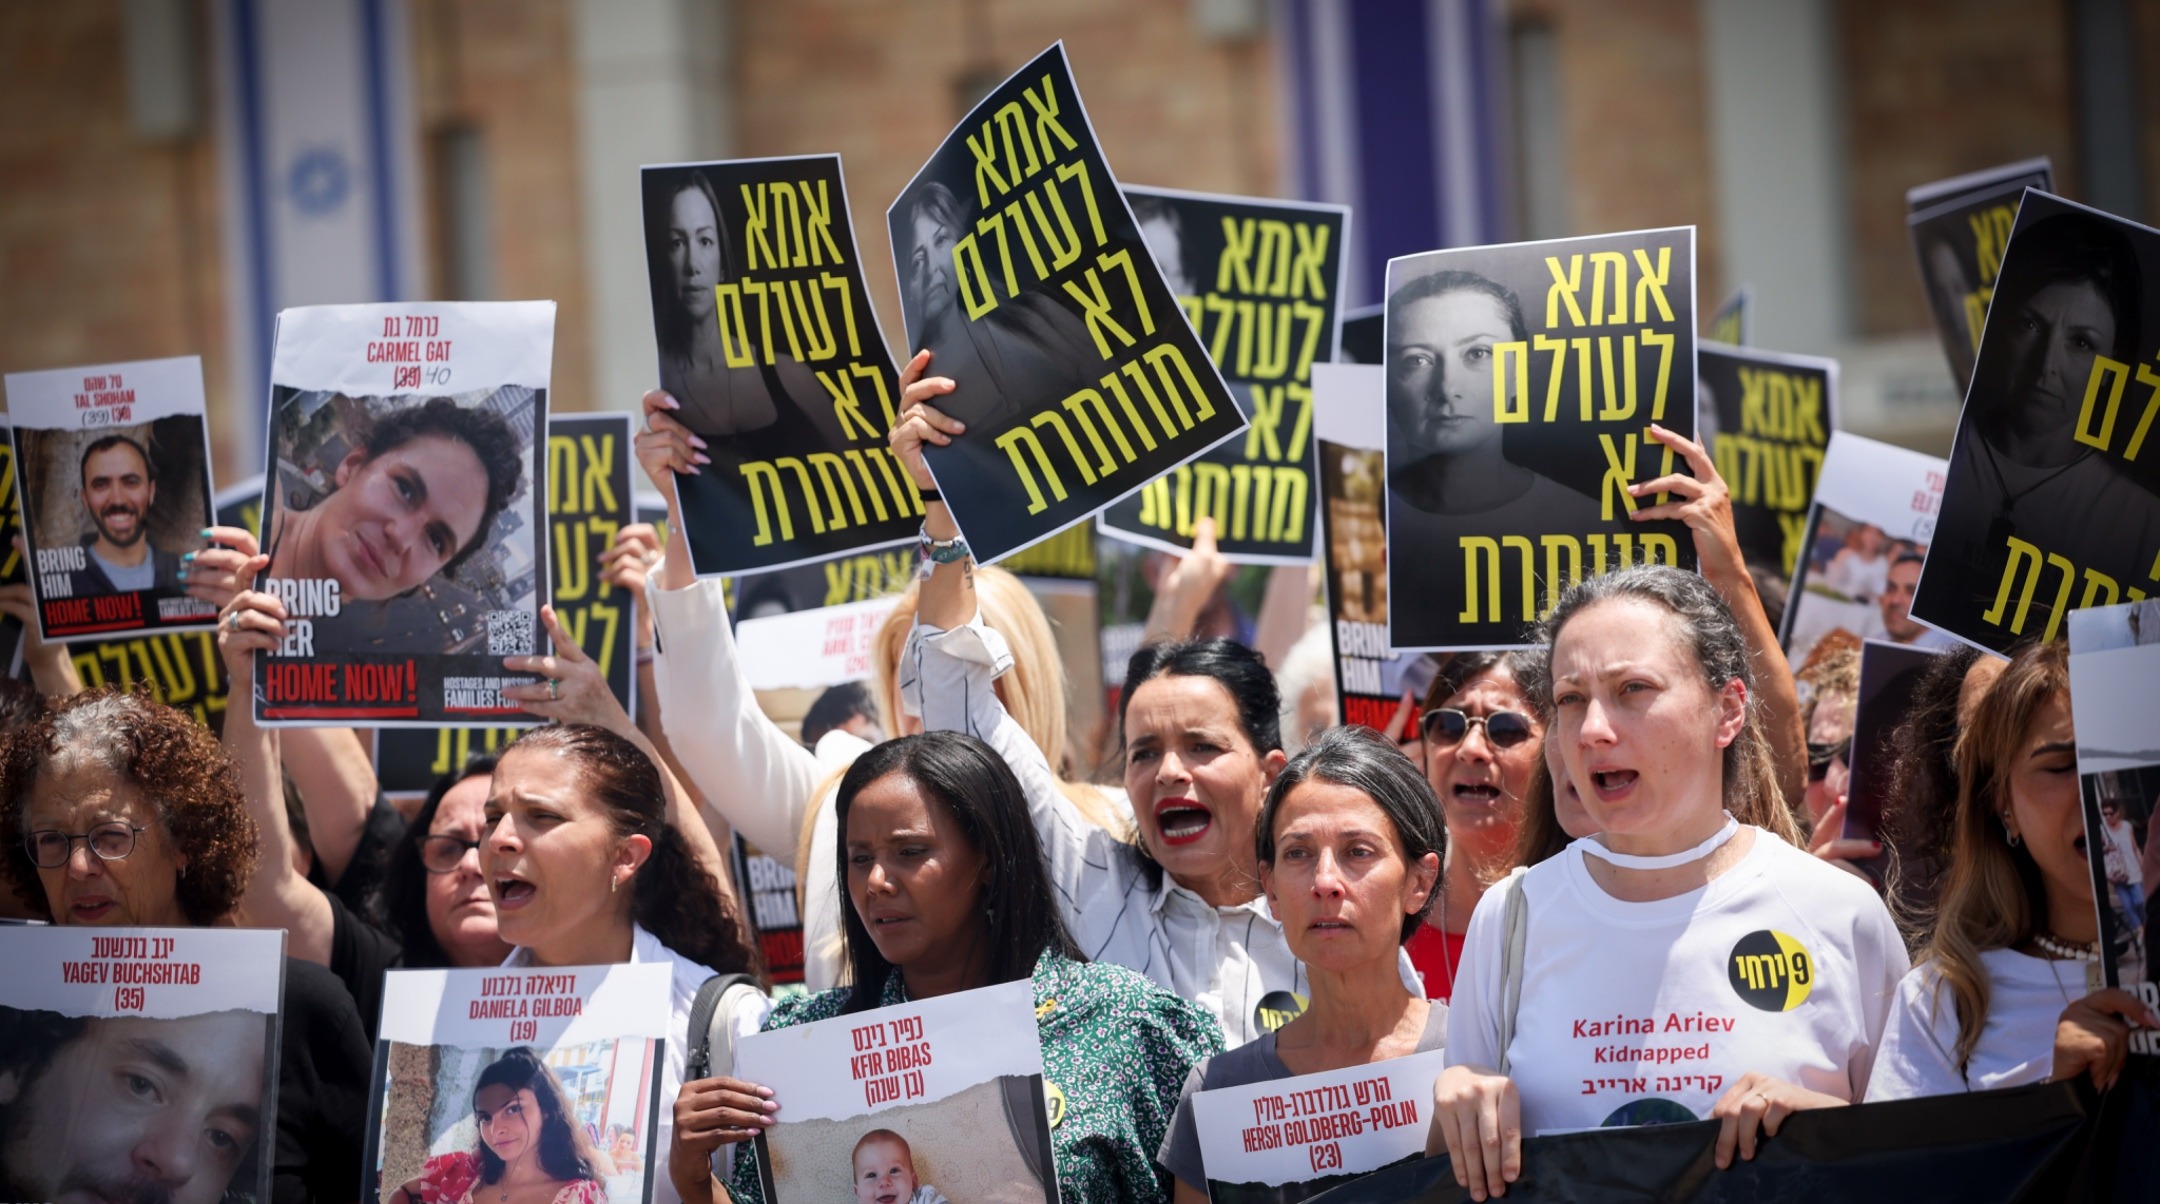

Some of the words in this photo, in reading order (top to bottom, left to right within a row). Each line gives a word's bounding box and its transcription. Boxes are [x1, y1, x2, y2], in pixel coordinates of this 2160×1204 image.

[967, 74, 1078, 210] אמא
[740, 179, 845, 271] אמא
[952, 159, 1109, 322] לעולם
[1217, 215, 1331, 299] אמא
[1545, 247, 1675, 329] אמא
[1062, 249, 1138, 361] לא
[383, 316, 401, 338] גת
[406, 315, 439, 338] כרמל
[715, 275, 862, 369] לעולם
[366, 341, 422, 363] CARMEL
[425, 340, 452, 362] GAT
[425, 365, 452, 386] 40
[1493, 330, 1675, 424] לעולם
[75, 394, 91, 408] TAL
[94, 389, 136, 407] SHOHAM
[815, 361, 898, 441] לא
[1737, 366, 1826, 445] אמא
[81, 408, 110, 427] (39)
[994, 343, 1217, 516] מוותרת
[1244, 383, 1313, 463] לא
[549, 433, 618, 514] אמ
[1599, 427, 1675, 522] לא
[36, 545, 86, 576] BRING
[40, 572, 74, 600] HIM
[45, 600, 91, 626] HOME
[94, 592, 143, 621] NOW!
[1337, 619, 1400, 662] BRIN
[266, 663, 338, 702] HOME
[344, 659, 417, 702] NOW!
[443, 676, 483, 689] HOSTAGES
[484, 677, 501, 689] AND
[1340, 656, 1383, 695] HIM
[444, 689, 495, 708] FAMILIES
[753, 889, 799, 930] HIM
[151, 937, 175, 960] יגב
[62, 962, 109, 984] YAGEV
[112, 963, 201, 985] BUCHSHTAB
[525, 975, 576, 995] דניאלה
[1736, 952, 1786, 991] ירחי
[1792, 951, 1810, 986] 9
[114, 987, 146, 1012] (35)
[481, 977, 522, 998] גלבוע
[469, 999, 528, 1020] DANIELA
[532, 997, 583, 1018] GILBOA
[1572, 1014, 1655, 1039] Karina
[1663, 1011, 1736, 1034] Ariev
[509, 1019, 538, 1043] (19)
[851, 1022, 887, 1052] ביבס
[888, 1015, 925, 1043] כפיר
[850, 1054, 884, 1080] KFIR
[886, 1042, 932, 1072] BIBAS
[1593, 1042, 1710, 1066] Kidnapped
[1353, 1076, 1392, 1107] הרש
[1581, 1076, 1647, 1095] ארייב
[1655, 1074, 1723, 1098] קרינה
[1253, 1083, 1351, 1127] גולדברג-פולין
[1242, 1125, 1283, 1153] HERSH
[1284, 1099, 1418, 1146] GOLDBERG-POLIN
[1309, 1141, 1343, 1174] (23)
